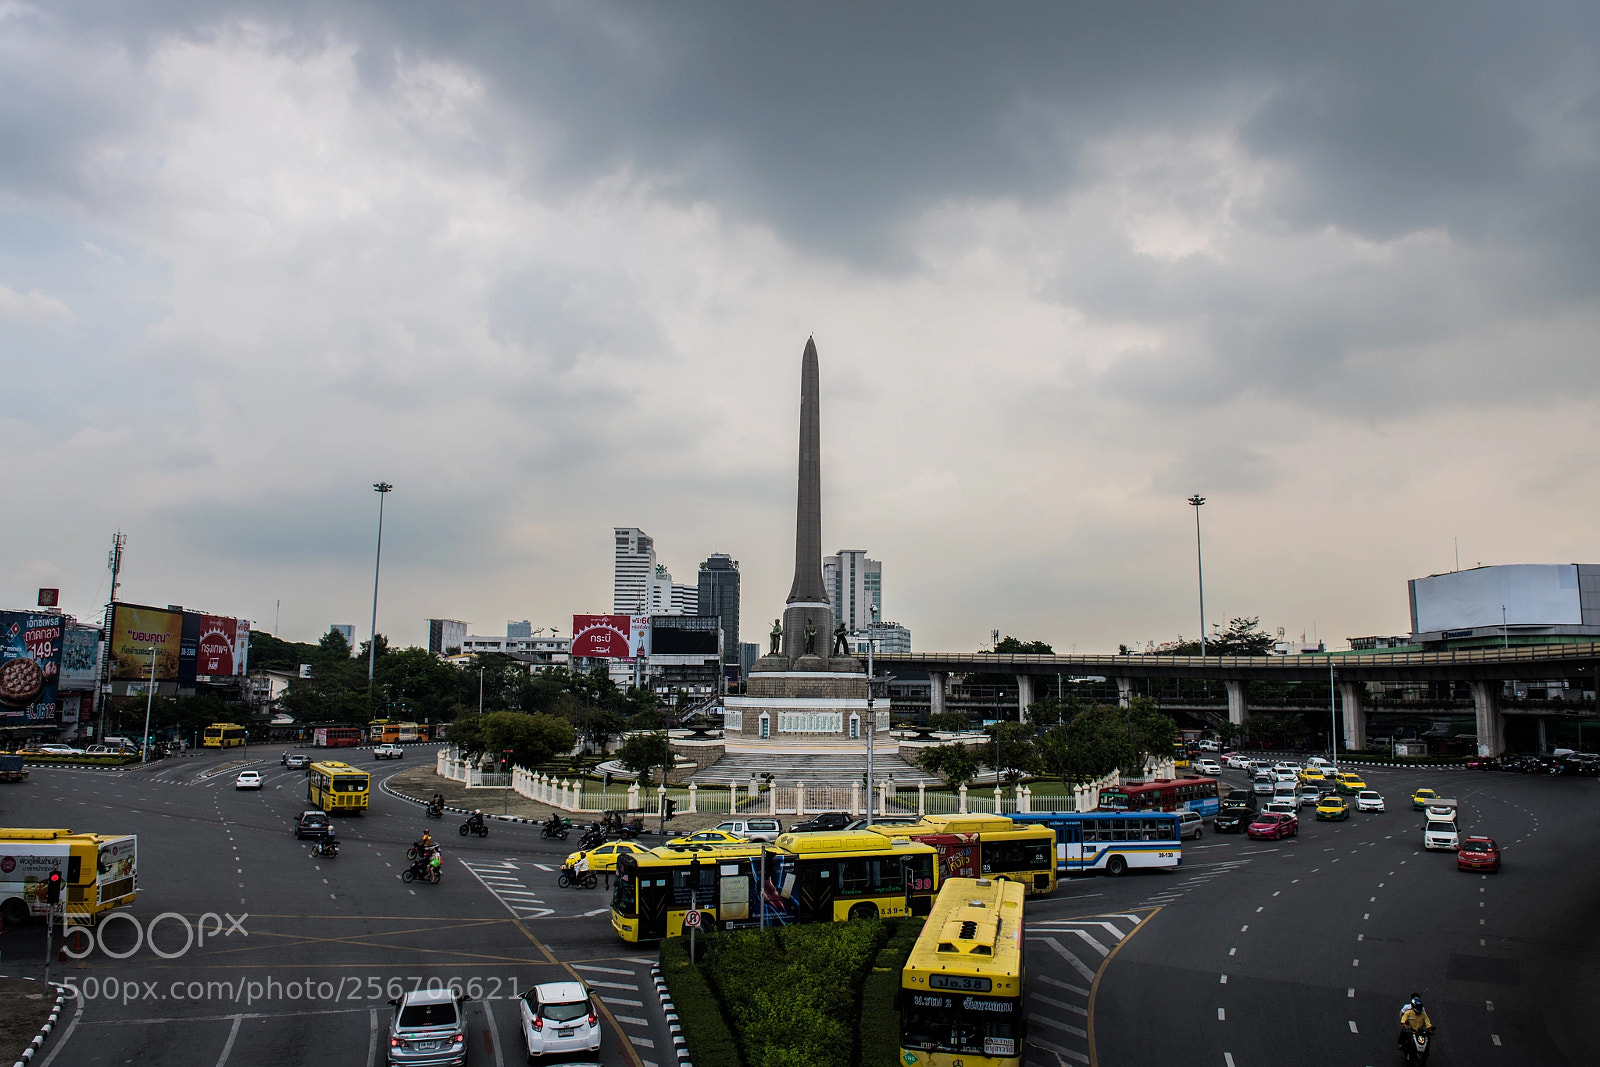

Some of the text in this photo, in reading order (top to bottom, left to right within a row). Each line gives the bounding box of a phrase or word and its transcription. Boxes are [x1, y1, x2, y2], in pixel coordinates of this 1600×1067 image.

[590, 631, 611, 643] กระบี่
[31, 641, 59, 659] 149.-
